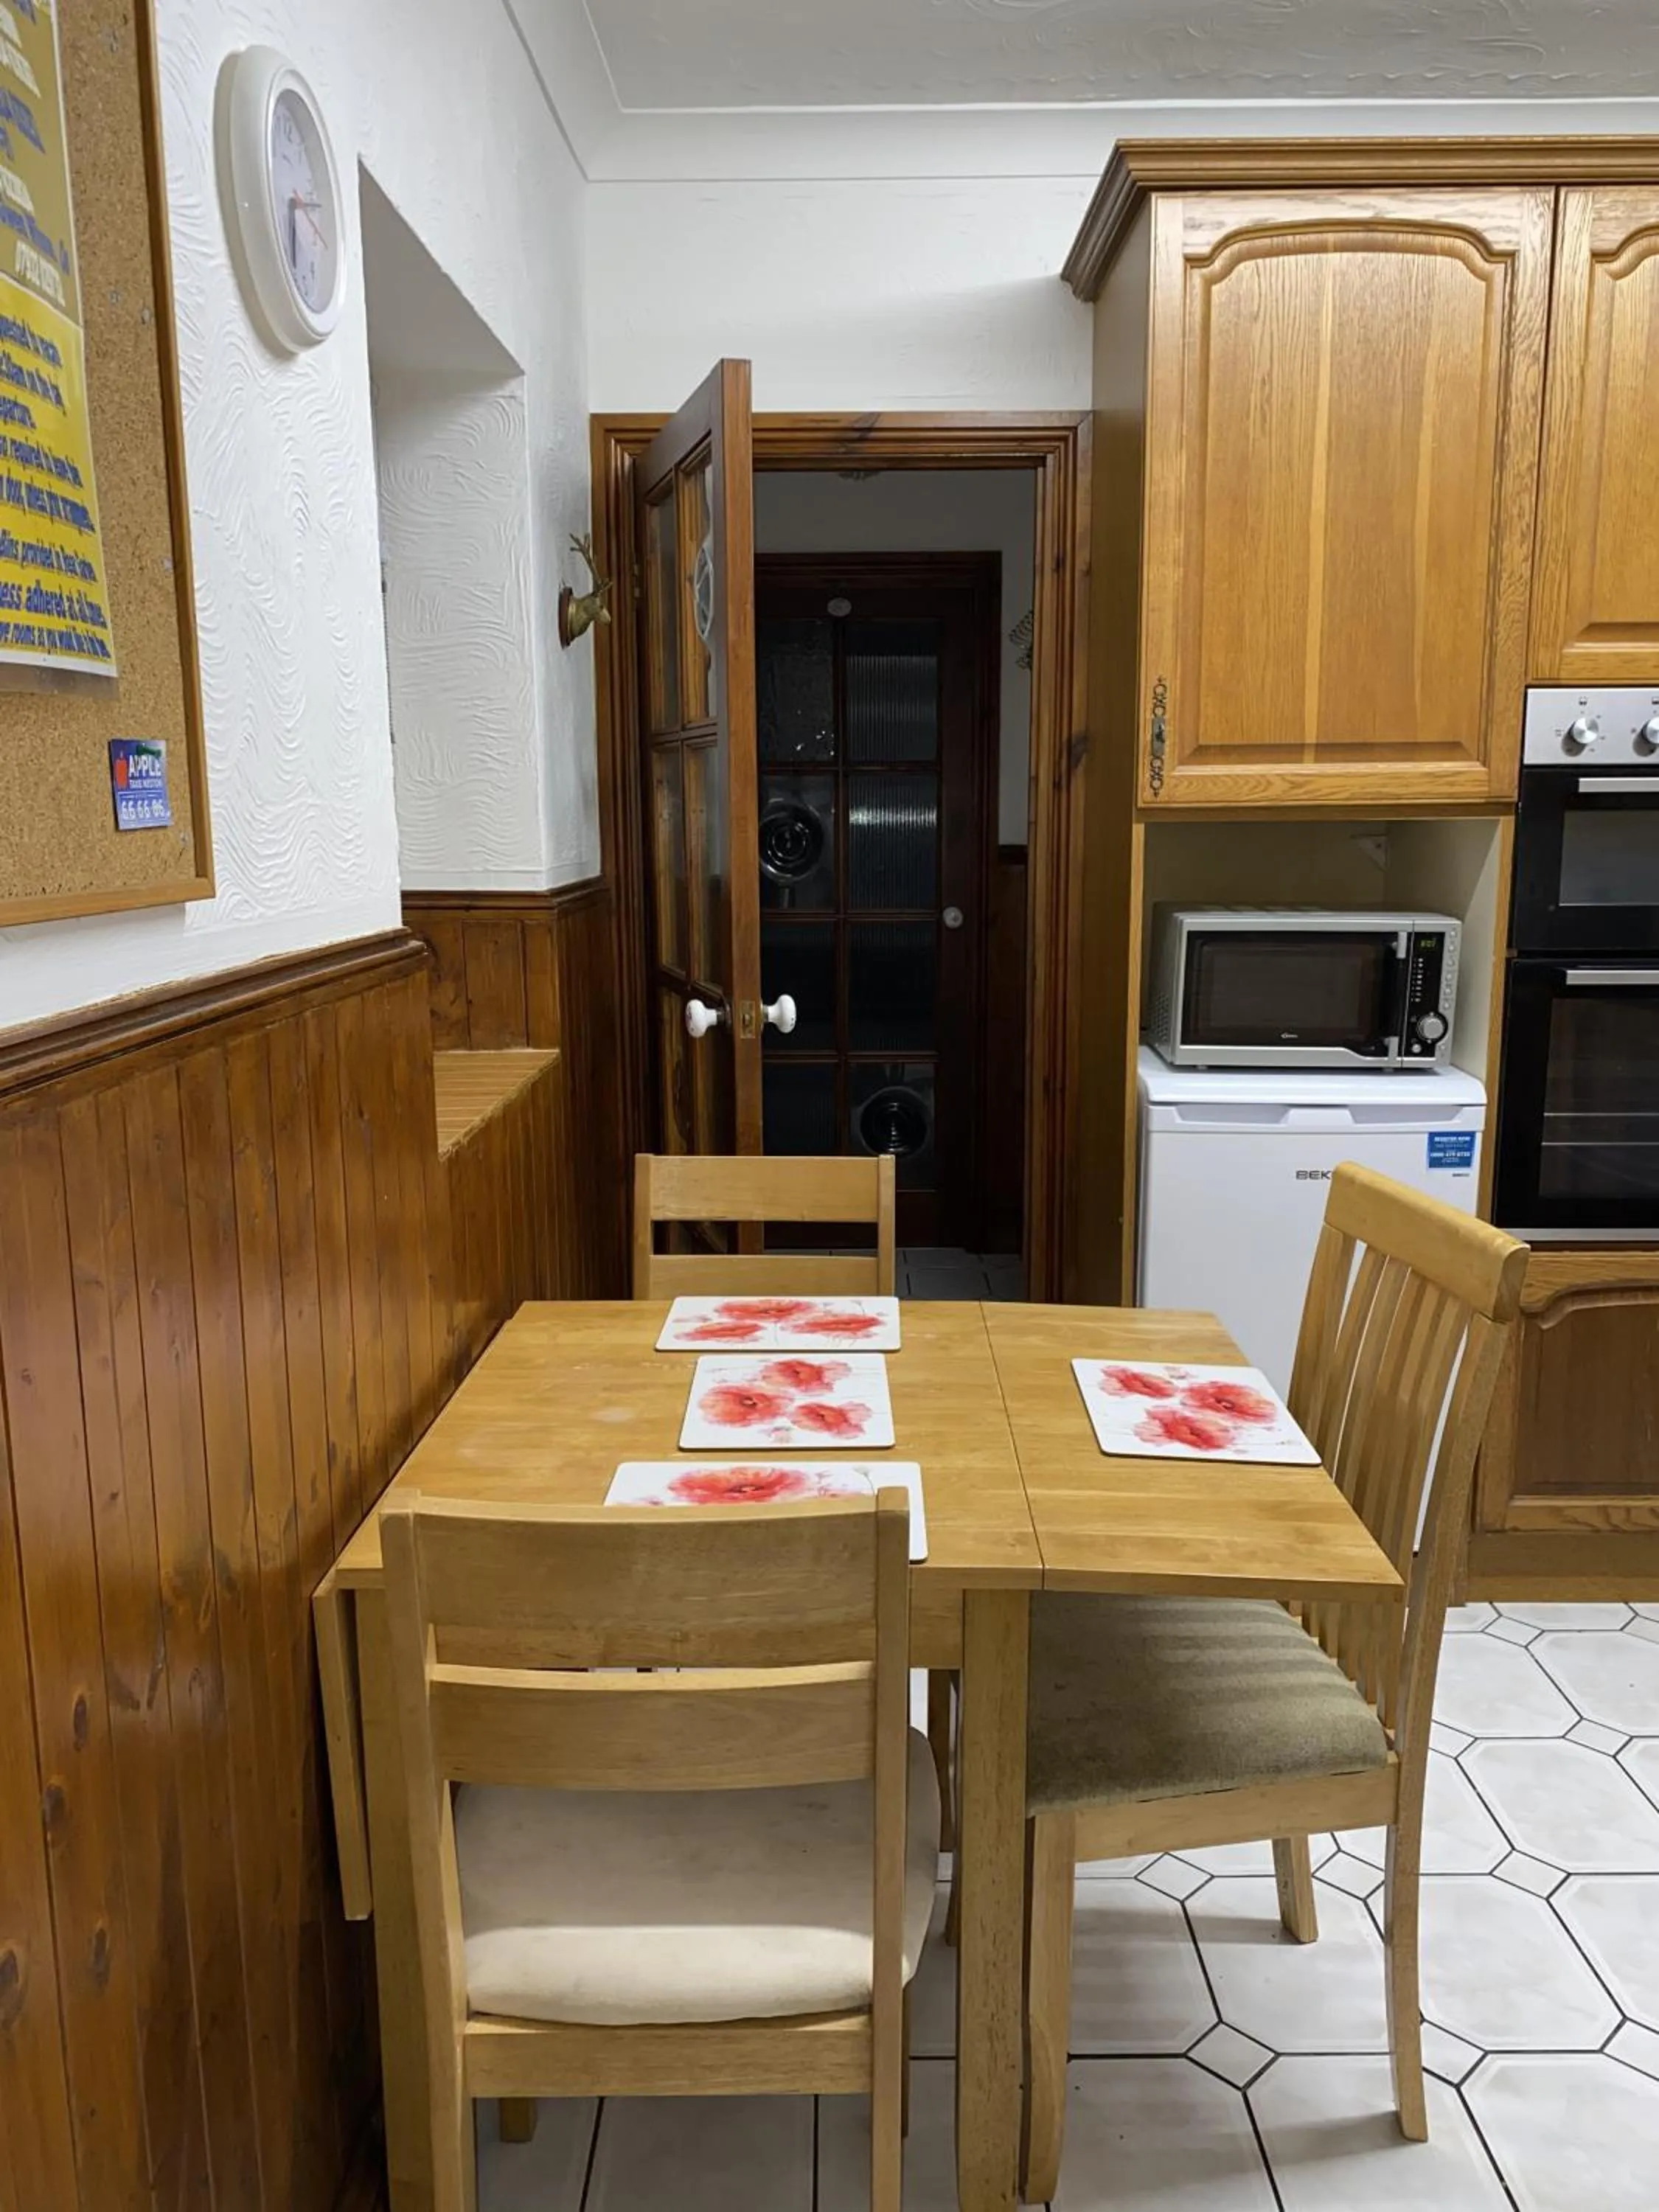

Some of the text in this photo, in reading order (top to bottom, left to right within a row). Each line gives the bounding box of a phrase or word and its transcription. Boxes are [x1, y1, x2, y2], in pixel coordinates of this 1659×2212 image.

[26, 579, 67, 619] adhered
[129, 754, 161, 777] APPLE
[1295, 1169, 1332, 1180] BEK
